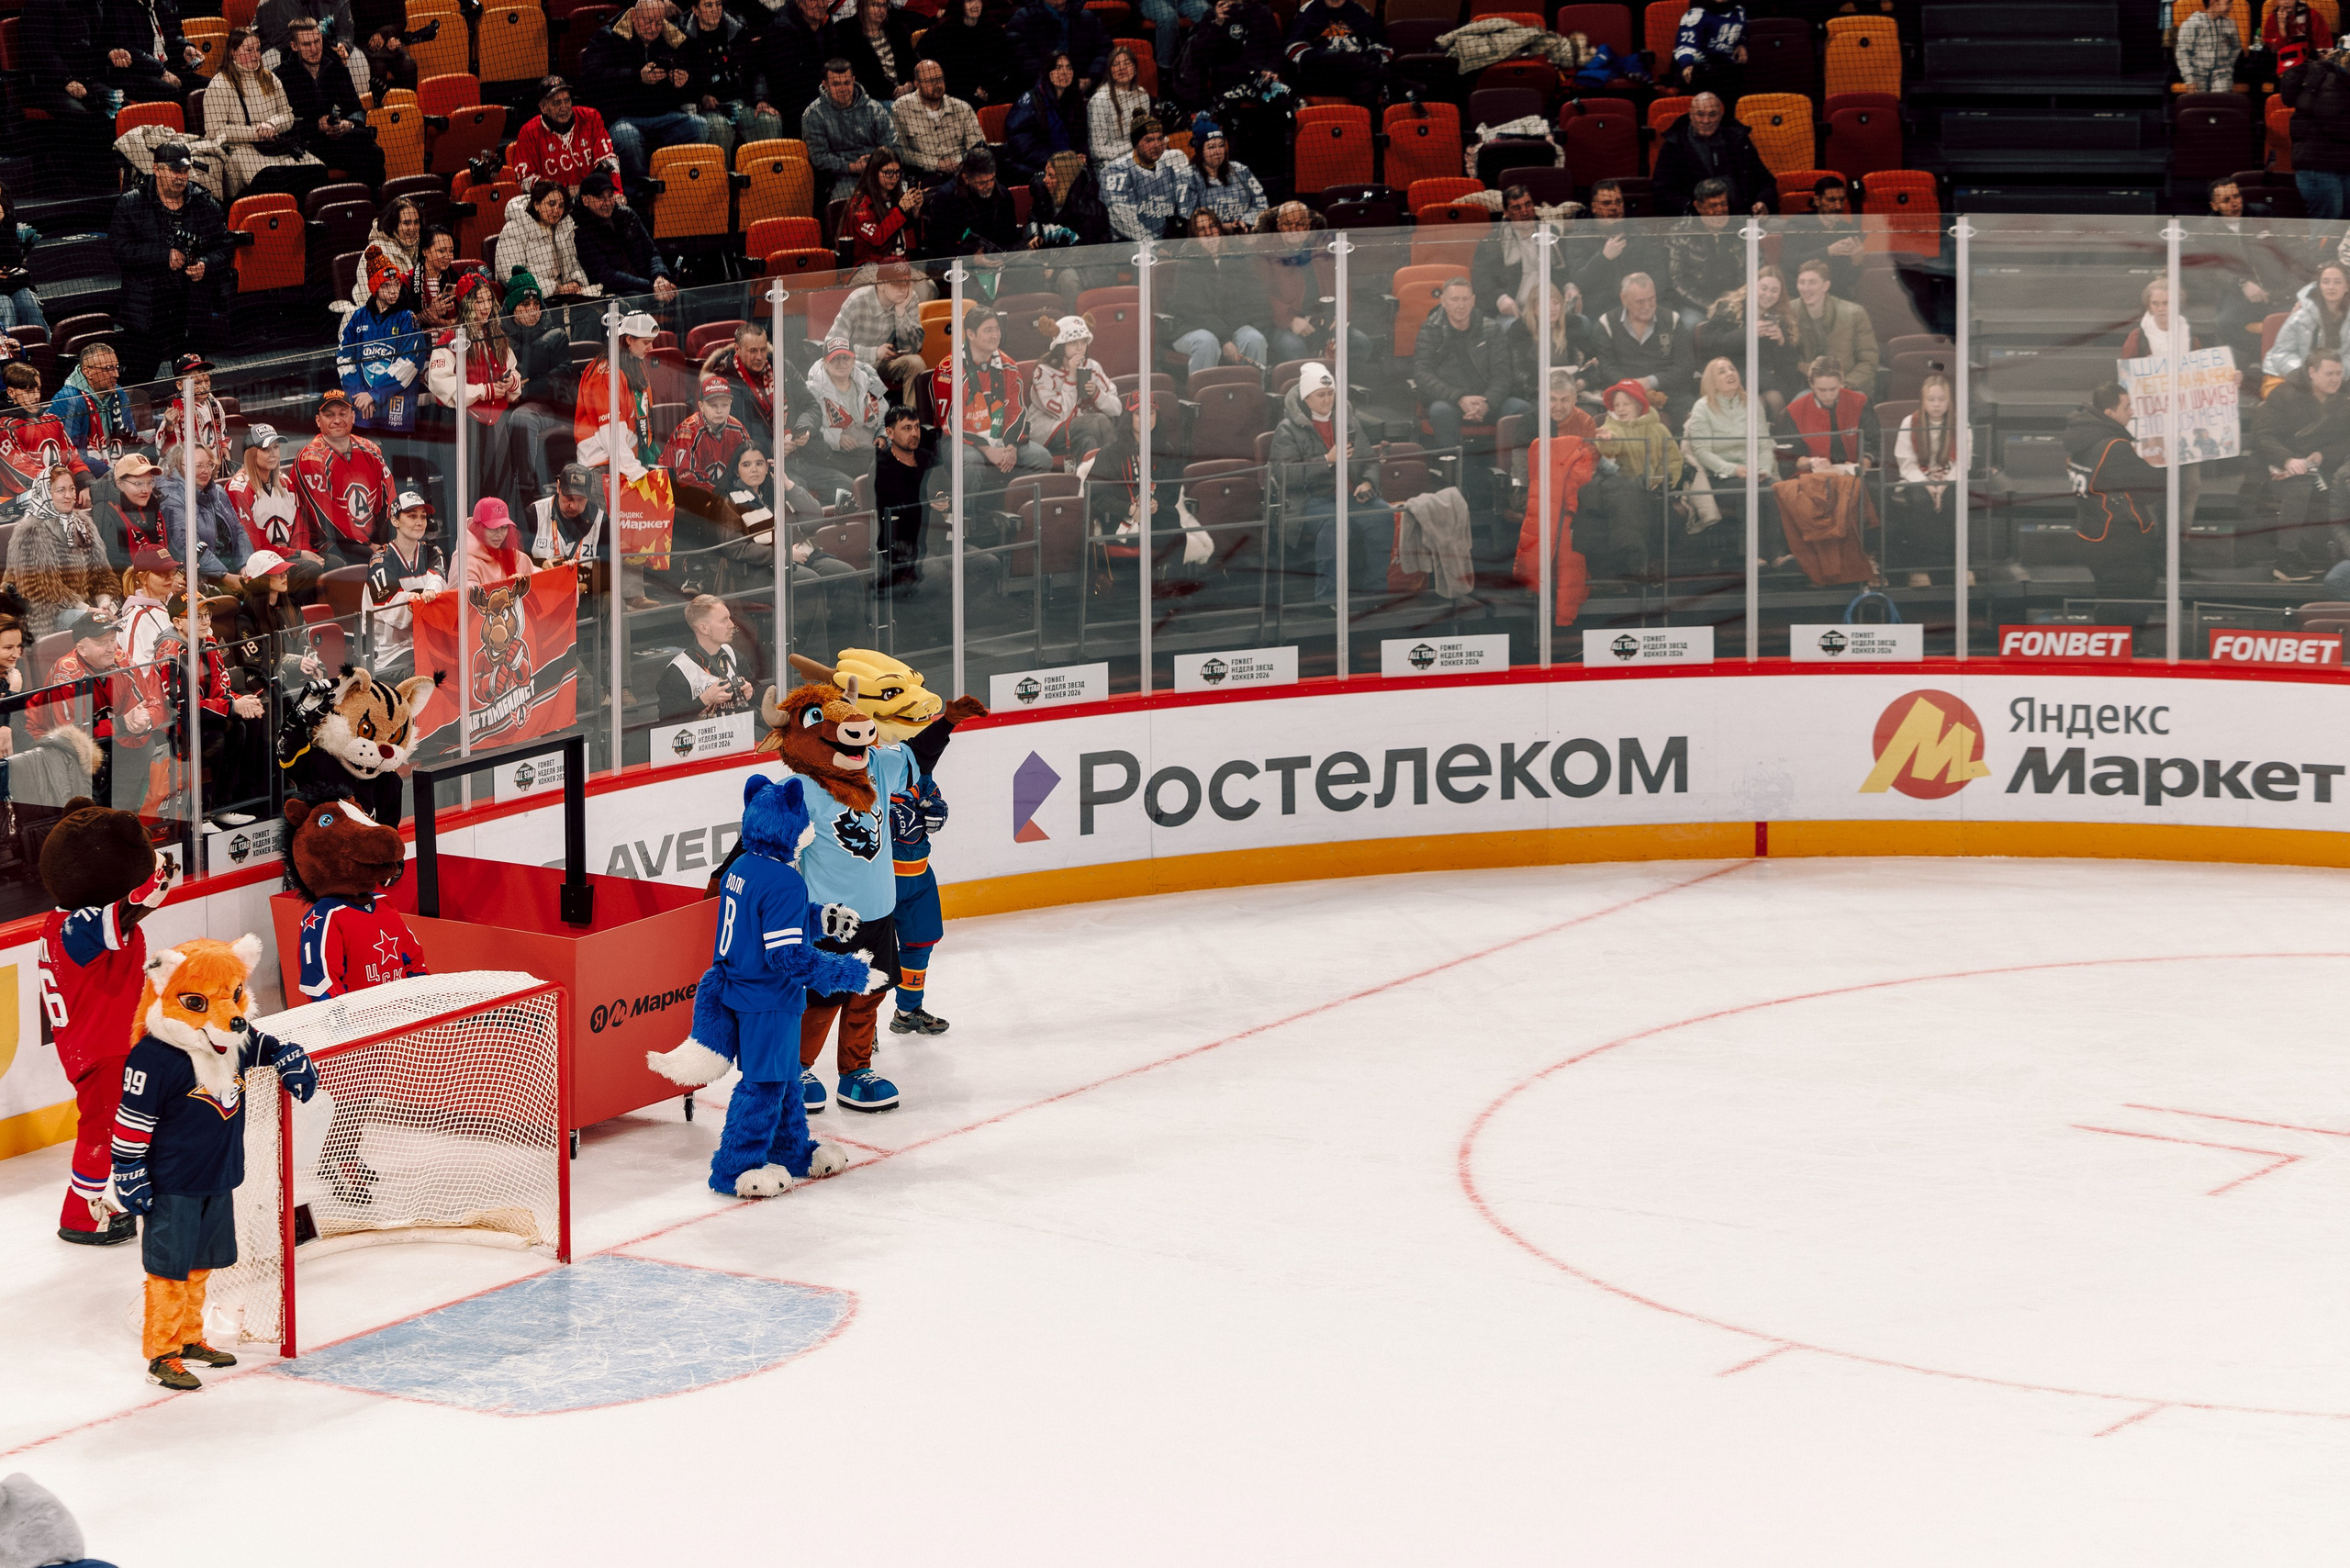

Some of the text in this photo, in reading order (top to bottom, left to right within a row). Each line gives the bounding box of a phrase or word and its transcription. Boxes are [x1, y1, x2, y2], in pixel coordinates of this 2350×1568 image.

[545, 148, 592, 175] СССР
[2134, 349, 2225, 377] ШИАЧЕВ
[2136, 393, 2186, 417] ПОДАИ
[620, 520, 670, 531] Маркет
[371, 566, 388, 592] 17
[241, 640, 259, 658] 18
[2001, 632, 2130, 656] FONBET
[2211, 635, 2340, 664] FONBET
[1231, 657, 1253, 666] FONBET
[1440, 651, 1463, 659] НЕДЕЛЯ
[1044, 675, 1065, 684] FONBET
[1044, 680, 1085, 692] НЕДЕЛЯ ЗВЕЗД
[1044, 689, 1081, 700] ХОККЕЯ 2026
[2009, 697, 2170, 740] Яндекс
[699, 726, 716, 735] FONBET
[699, 731, 734, 745] НЕДЕЛЯ ЗВЕЗД
[699, 739, 731, 752] ХОККЕЯ 2026
[538, 759, 554, 769] FONBET
[538, 767, 555, 778] НЕДЕЛЯ
[538, 773, 565, 786] ХОККЕЯ 202
[2005, 746, 2345, 806] Маркет
[1080, 735, 1688, 836] Ростелеком
[252, 830, 270, 840] FONBET
[252, 837, 271, 849] НЕДЕЛЯ
[252, 846, 271, 857] ХОККЕЯ
[541, 822, 743, 879] AVED
[725, 872, 745, 895] ВОЛК
[304, 942, 312, 964] 1
[630, 981, 699, 1018] Марке
[274, 1048, 305, 1070] OYUZ
[122, 1066, 147, 1096] 99
[113, 1168, 147, 1182] OYUZ
